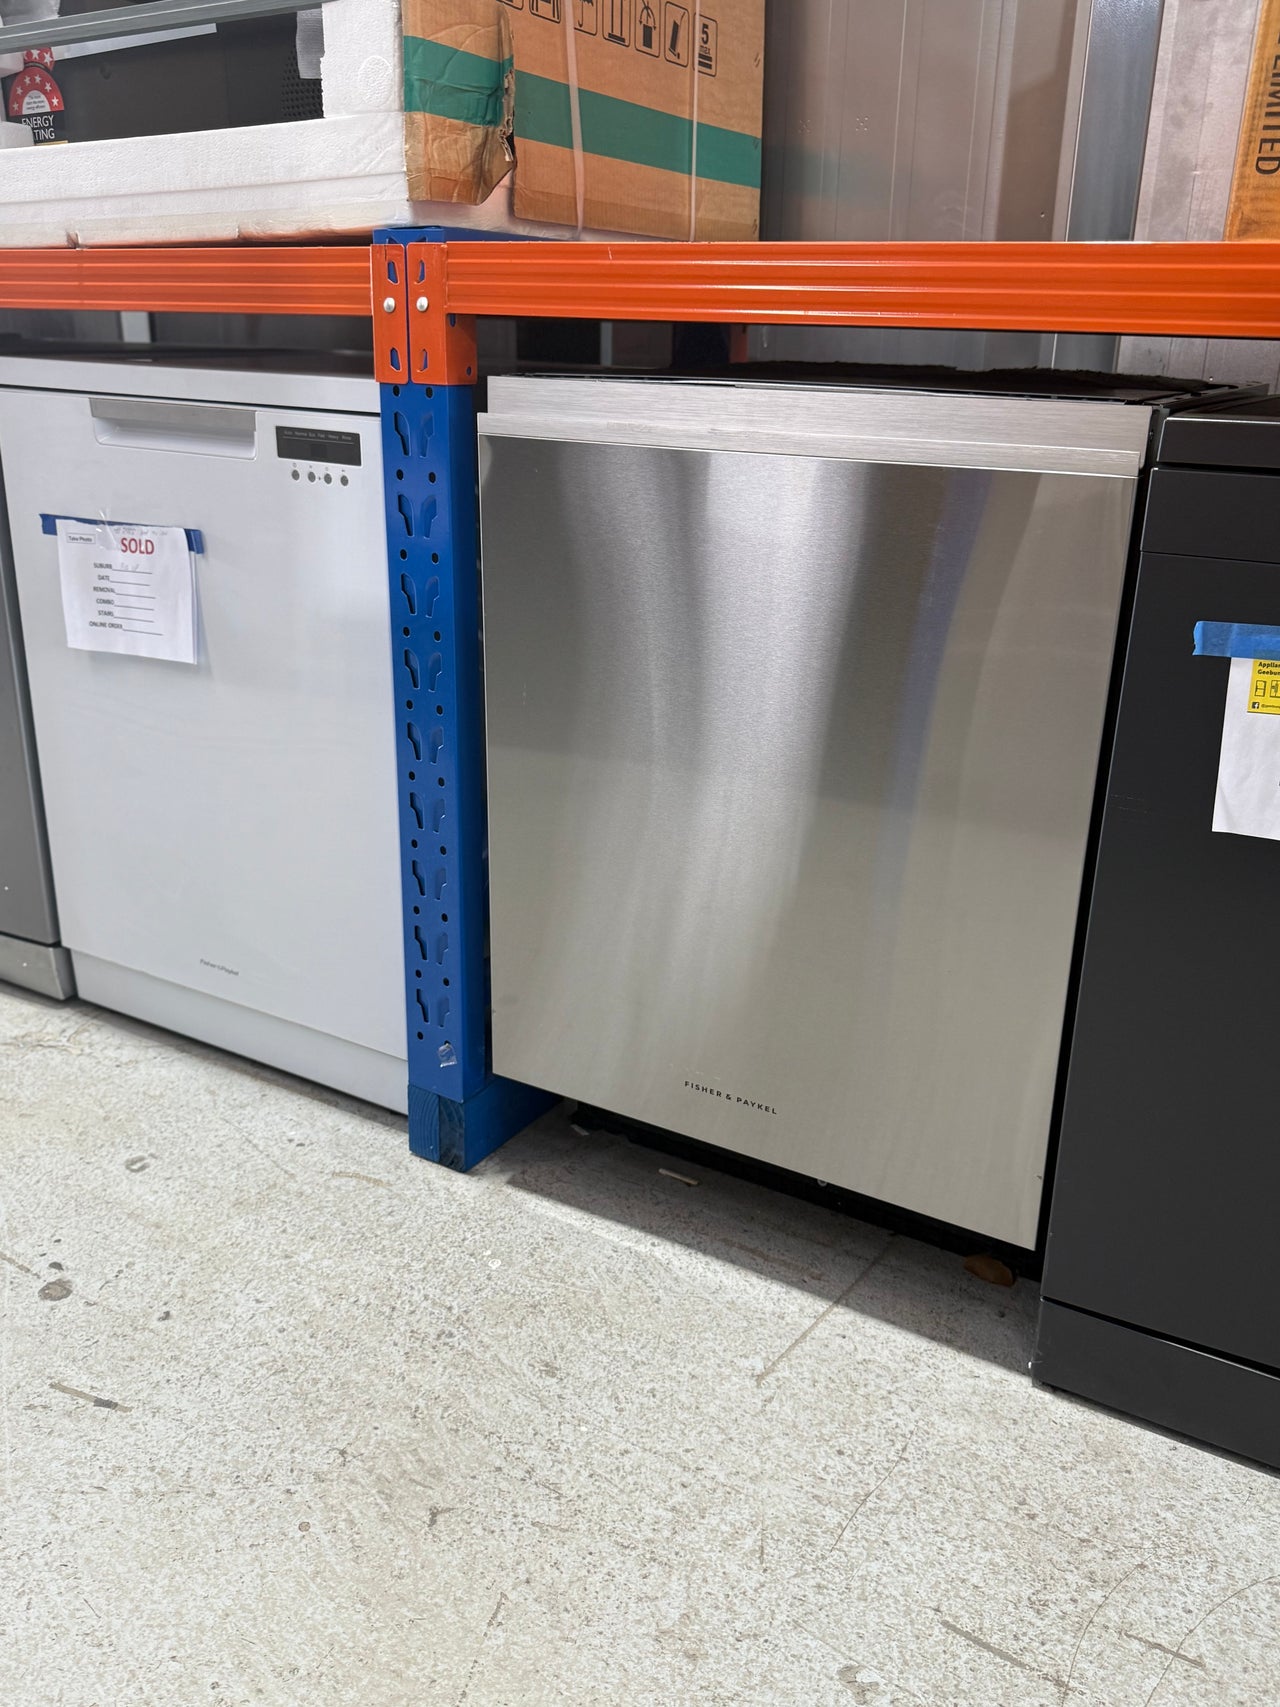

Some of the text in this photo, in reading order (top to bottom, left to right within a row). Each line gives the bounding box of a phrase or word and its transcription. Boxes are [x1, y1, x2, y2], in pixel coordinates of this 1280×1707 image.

[701, 23, 709, 45] 5
[21, 115, 54, 128] ENERGY
[1256, 54, 1280, 175] MITED
[33, 128, 55, 141] TING
[120, 537, 155, 555] SOLD
[93, 586, 116, 594] REMOVAL
[89, 620, 107, 628] ONLINE
[684, 1080, 777, 1115] FISHER & PAYKEL
